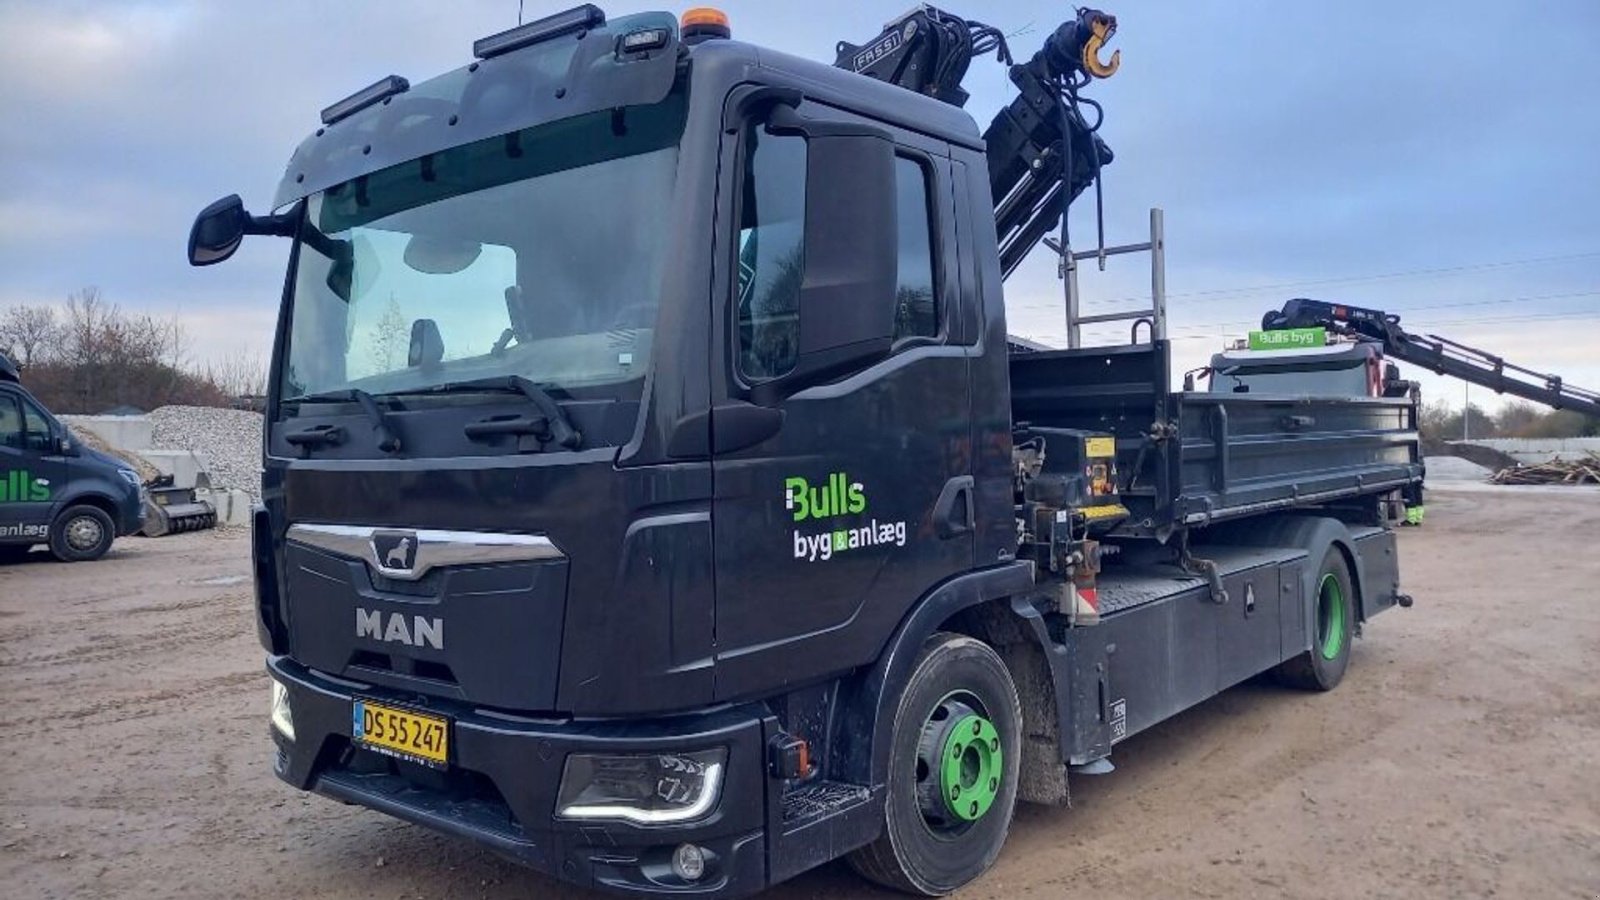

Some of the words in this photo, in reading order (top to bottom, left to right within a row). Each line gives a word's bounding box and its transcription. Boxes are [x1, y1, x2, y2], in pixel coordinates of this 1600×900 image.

[857, 36, 897, 67] FASSI
[1260, 331, 1289, 344] Bulls
[1291, 331, 1314, 344] byg
[785, 472, 866, 521] Bulls
[355, 607, 444, 650] MAN
[364, 709, 384, 738] DS
[389, 714, 408, 745] 55
[412, 720, 443, 753] 247
